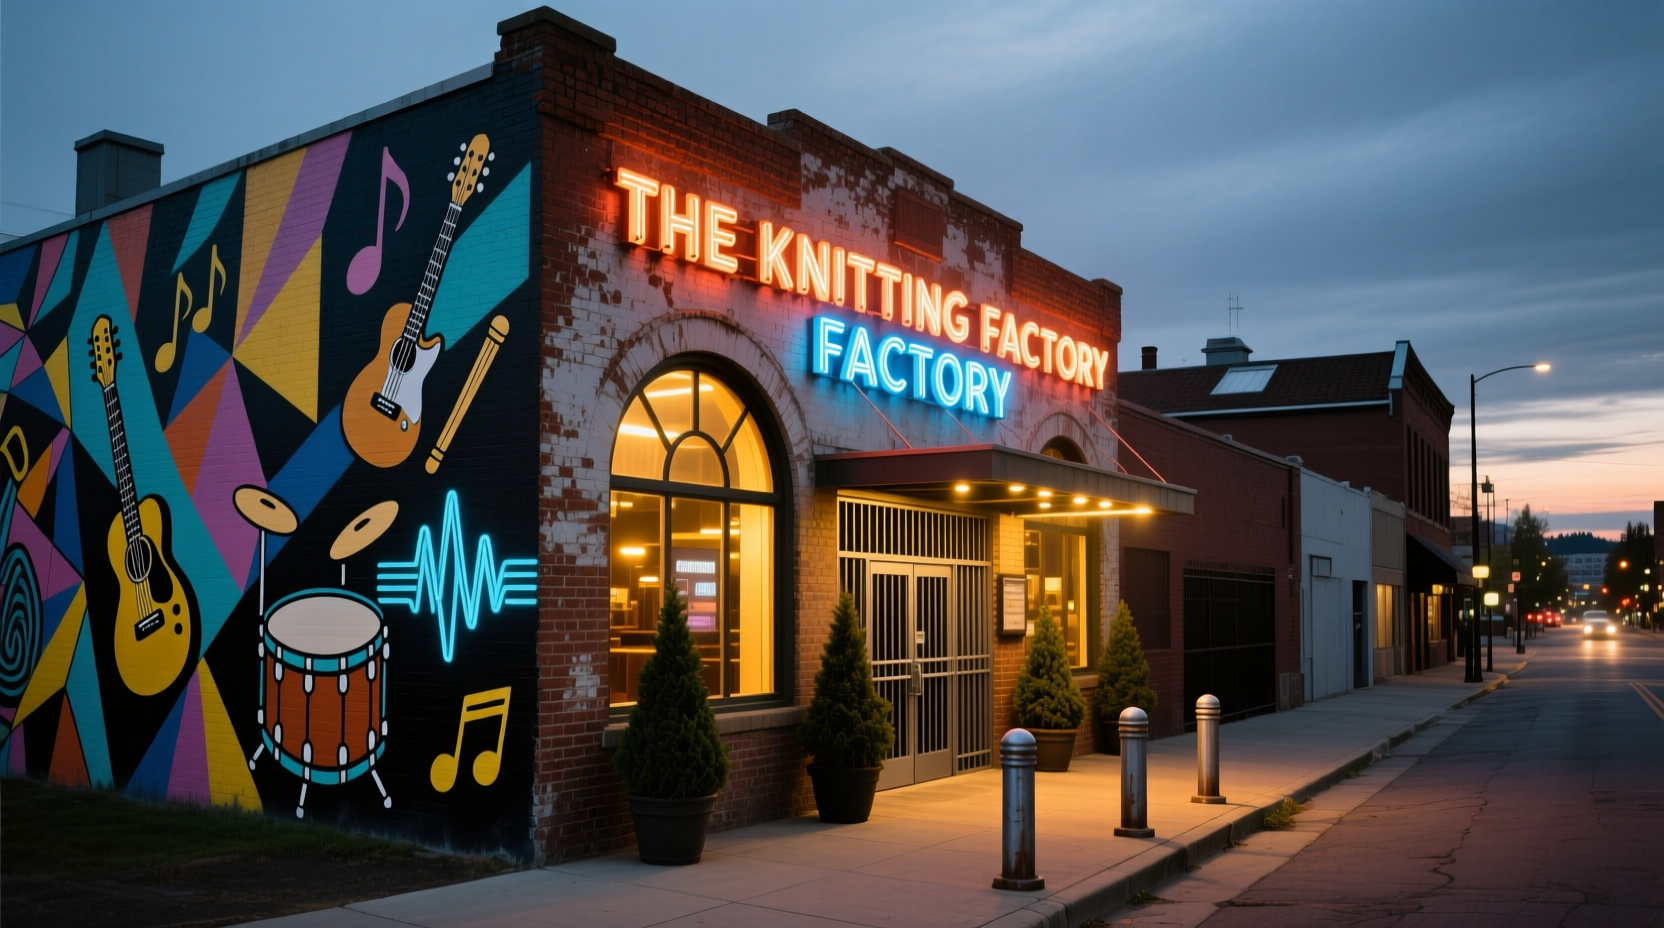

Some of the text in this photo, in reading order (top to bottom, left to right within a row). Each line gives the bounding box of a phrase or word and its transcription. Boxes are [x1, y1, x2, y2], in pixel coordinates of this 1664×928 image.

[615, 167, 1108, 390] THE KNITTING FACTORY
[815, 317, 1011, 418] FACTORY
